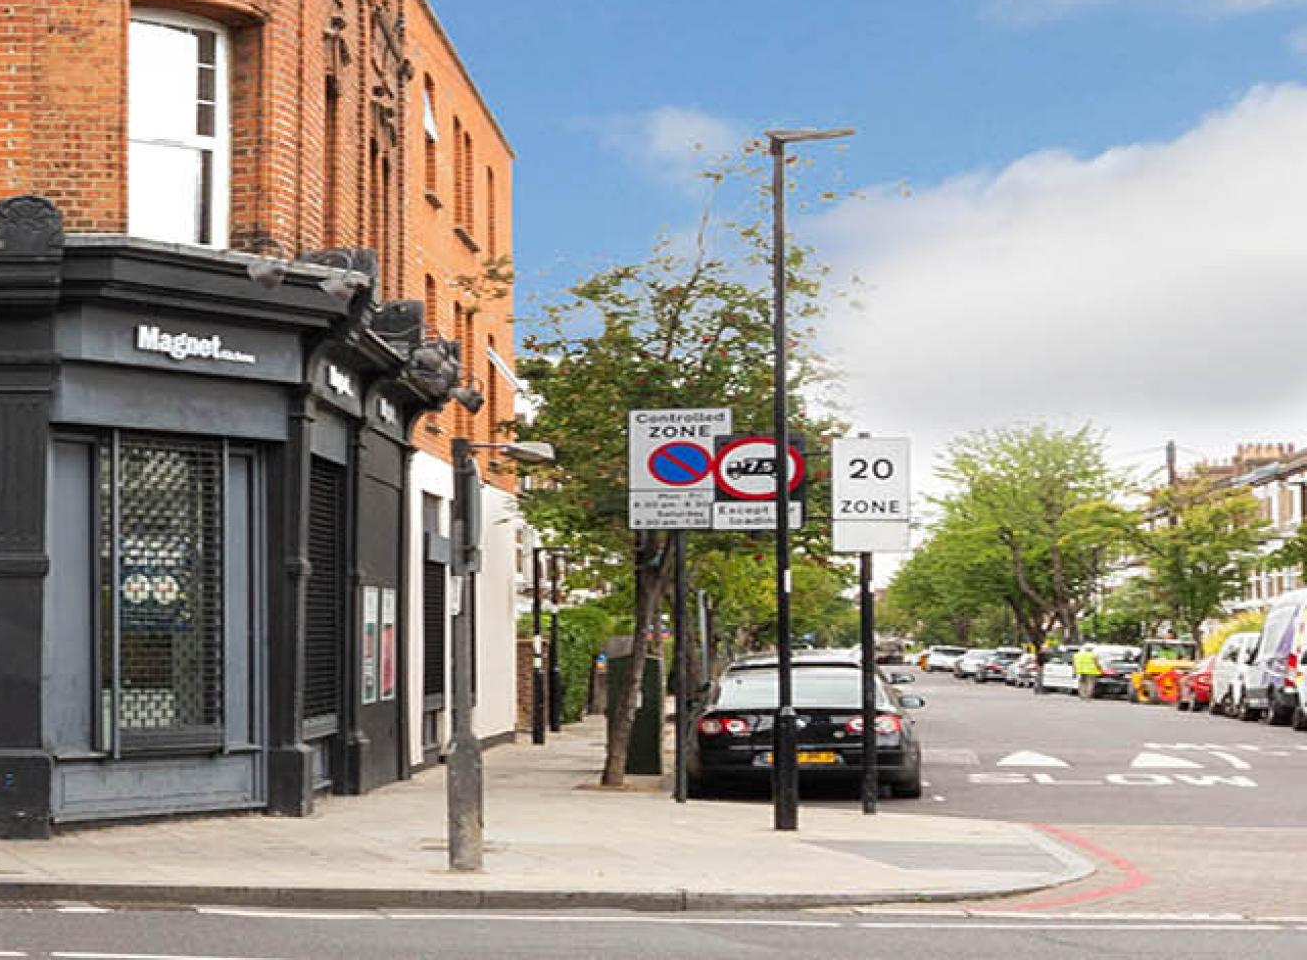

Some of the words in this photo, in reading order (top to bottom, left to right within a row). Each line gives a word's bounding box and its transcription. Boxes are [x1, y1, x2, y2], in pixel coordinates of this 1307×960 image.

[138, 324, 221, 360] Magnet
[636, 412, 726, 423] Controlled
[649, 425, 712, 438] ZONE
[849, 459, 894, 479] 20
[840, 500, 900, 513] ZONE
[966, 772, 1259, 788] SLOW
